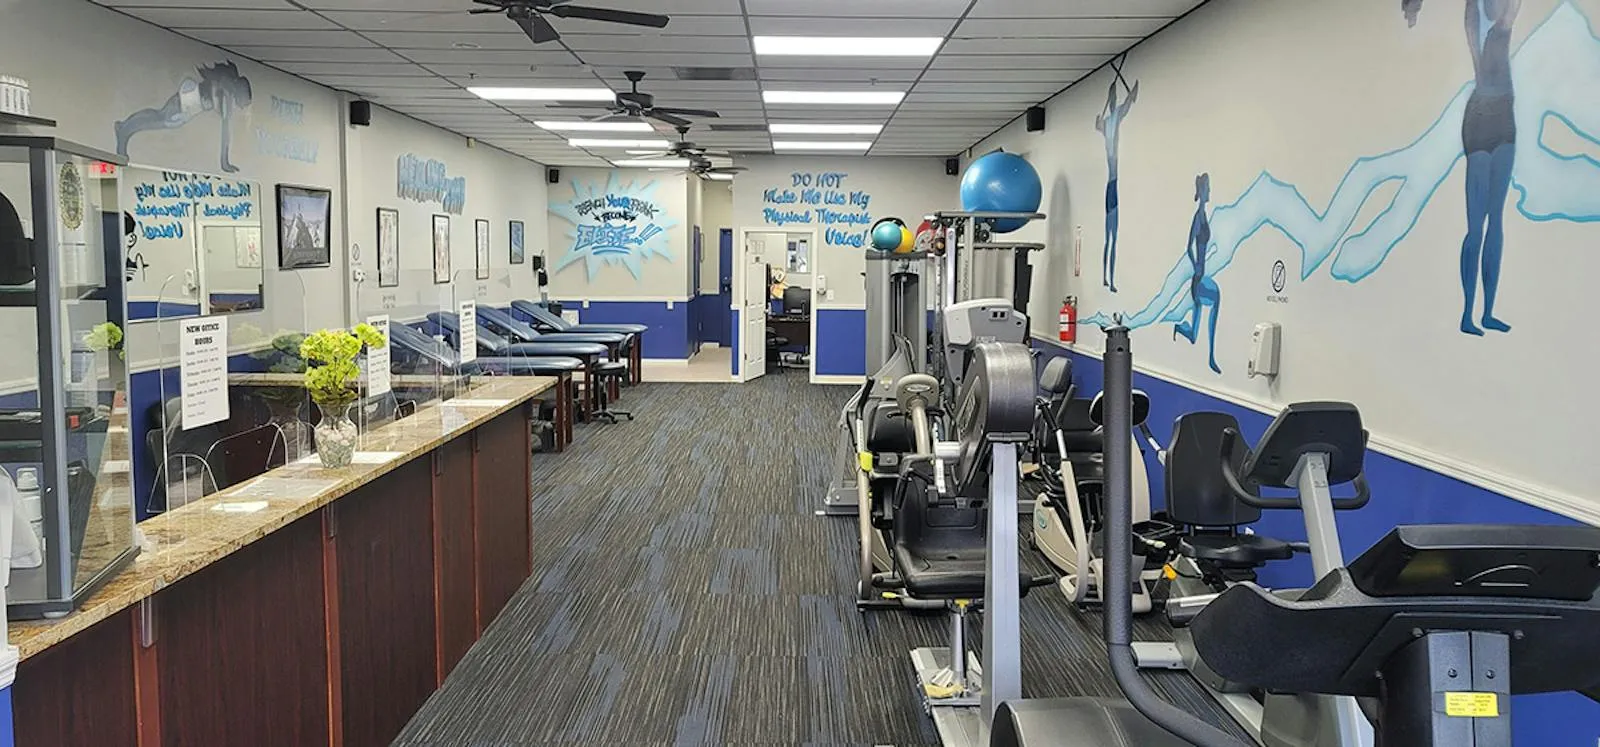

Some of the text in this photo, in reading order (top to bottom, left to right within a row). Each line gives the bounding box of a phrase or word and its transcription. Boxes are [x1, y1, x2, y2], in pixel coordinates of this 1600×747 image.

[791, 172, 848, 188] DO NOT
[849, 190, 871, 210] My
[763, 207, 812, 226] Physical
